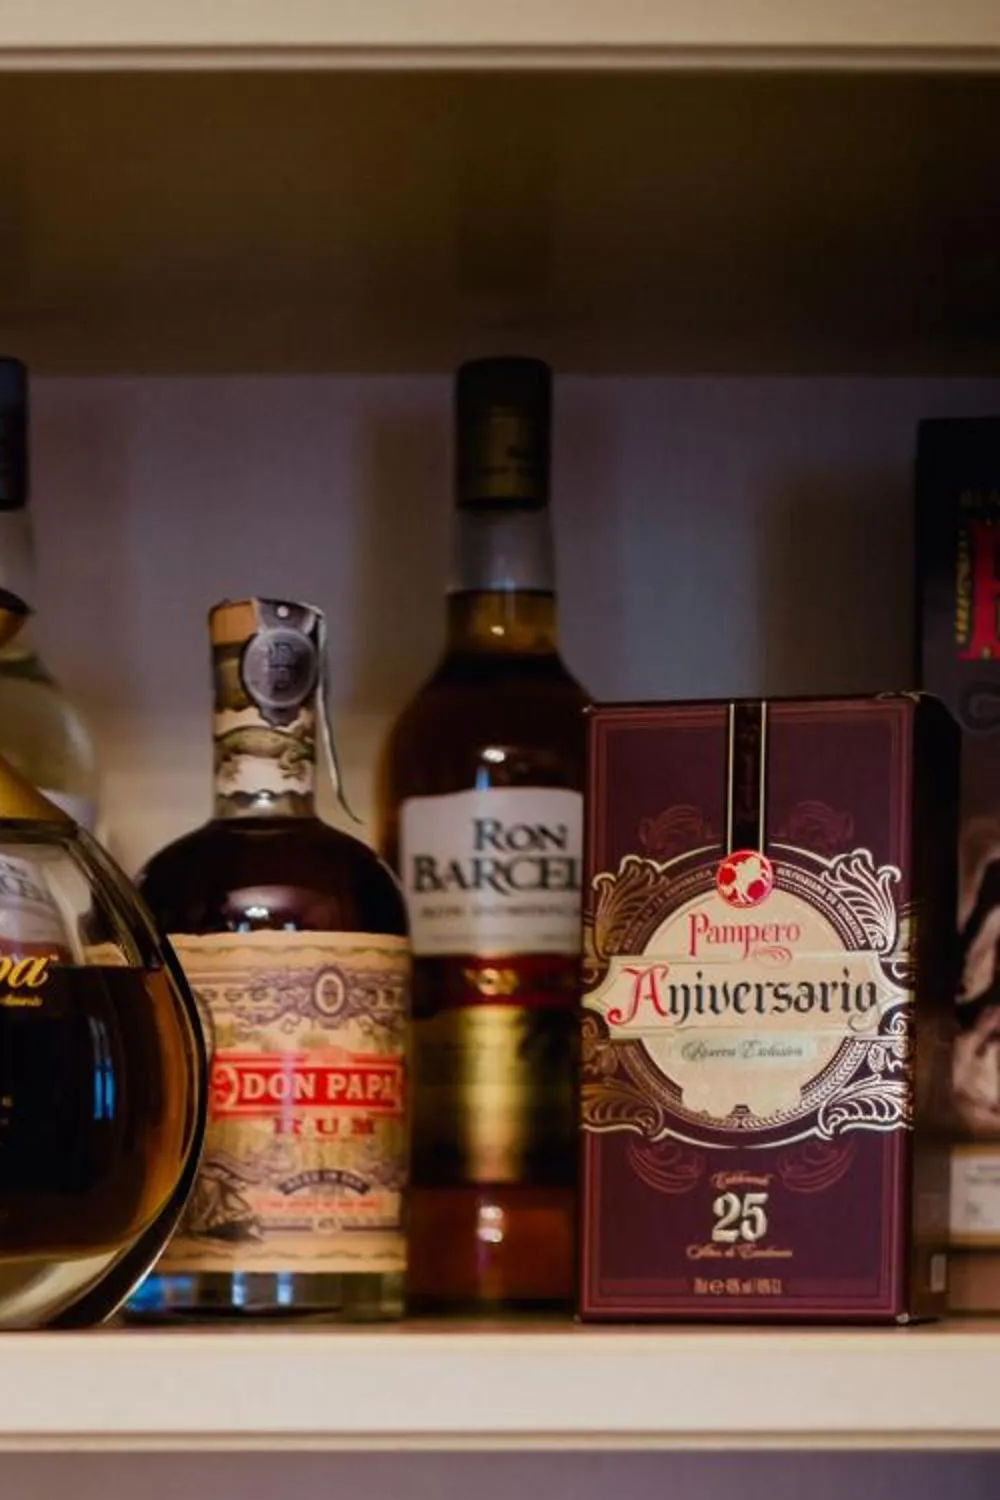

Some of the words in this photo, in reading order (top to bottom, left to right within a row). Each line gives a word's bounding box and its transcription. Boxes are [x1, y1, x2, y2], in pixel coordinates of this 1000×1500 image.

[687, 912, 801, 960] Pampero
[606, 963, 878, 1030] Aniversario
[243, 1073, 316, 1100] DON
[326, 1074, 393, 1099] PAPA
[274, 1117, 375, 1135] RUM
[712, 1191, 769, 1243] 25
